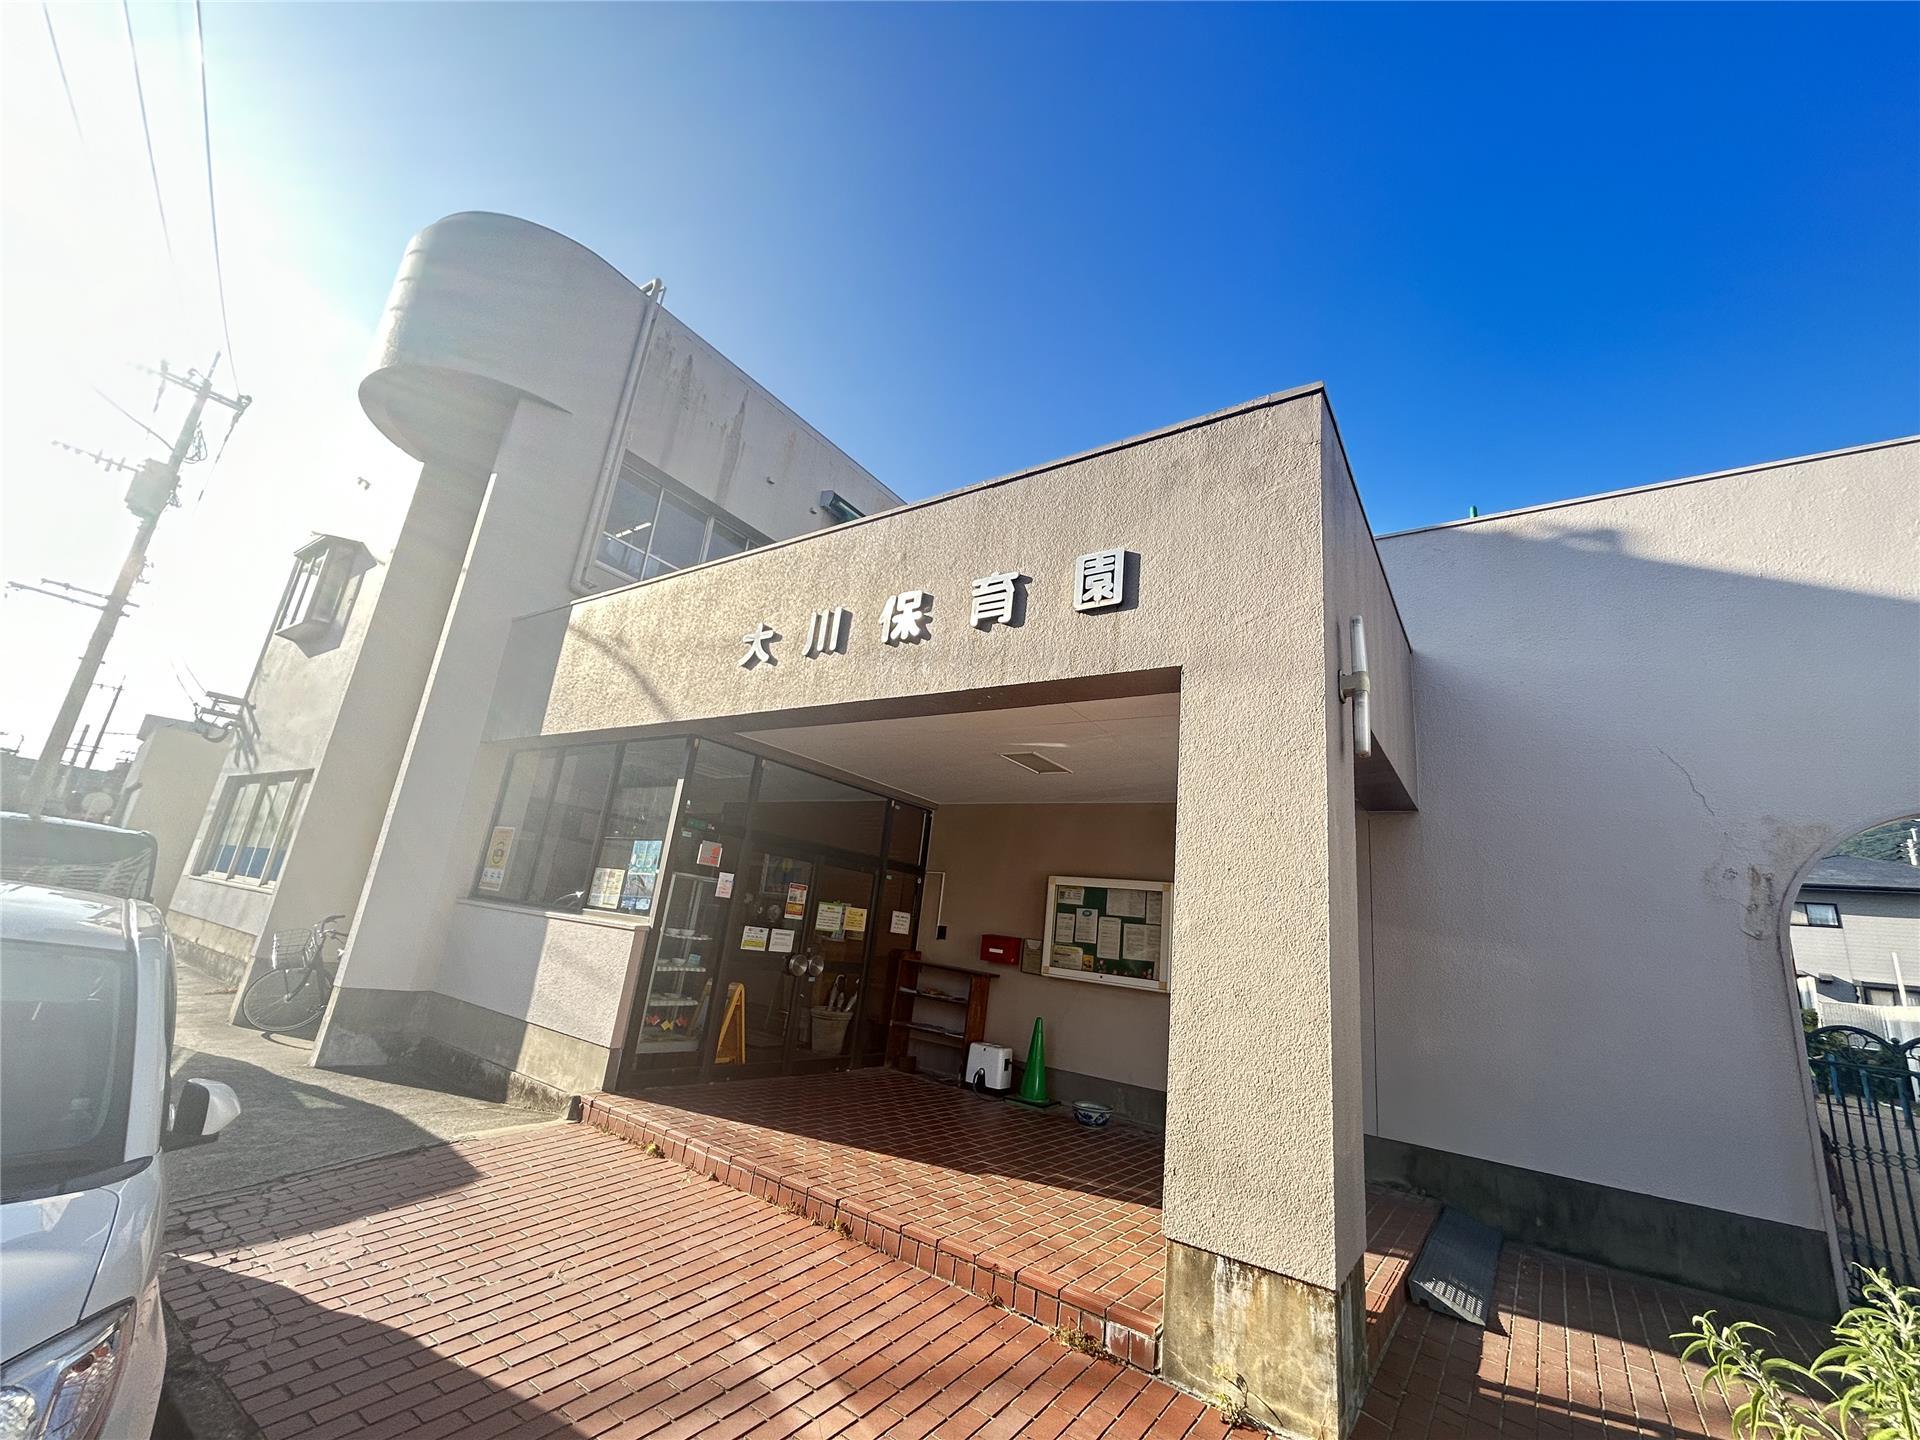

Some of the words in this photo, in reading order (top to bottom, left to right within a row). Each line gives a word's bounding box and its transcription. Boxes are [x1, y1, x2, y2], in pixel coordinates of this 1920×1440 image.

[738, 548, 1126, 666] 大川保育園
